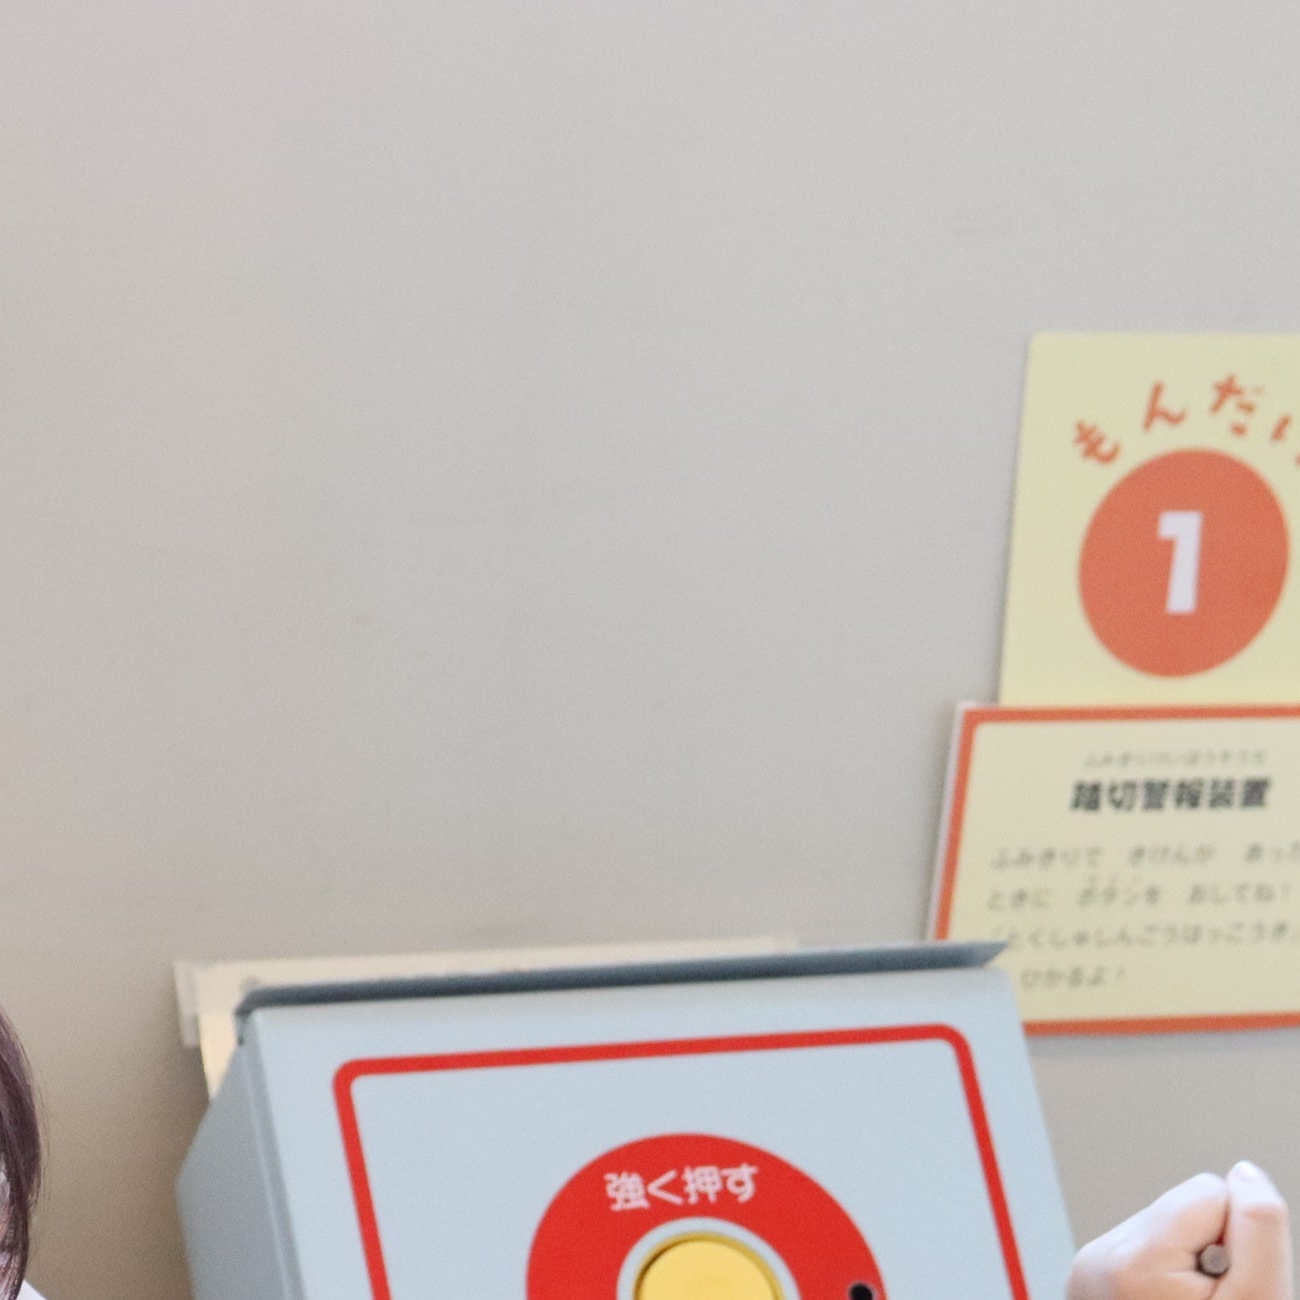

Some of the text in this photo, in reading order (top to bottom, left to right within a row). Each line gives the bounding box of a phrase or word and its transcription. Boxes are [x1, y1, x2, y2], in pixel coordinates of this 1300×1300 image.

[1158, 510, 1203, 614] 1
[605, 1163, 758, 1211] 強く押す
